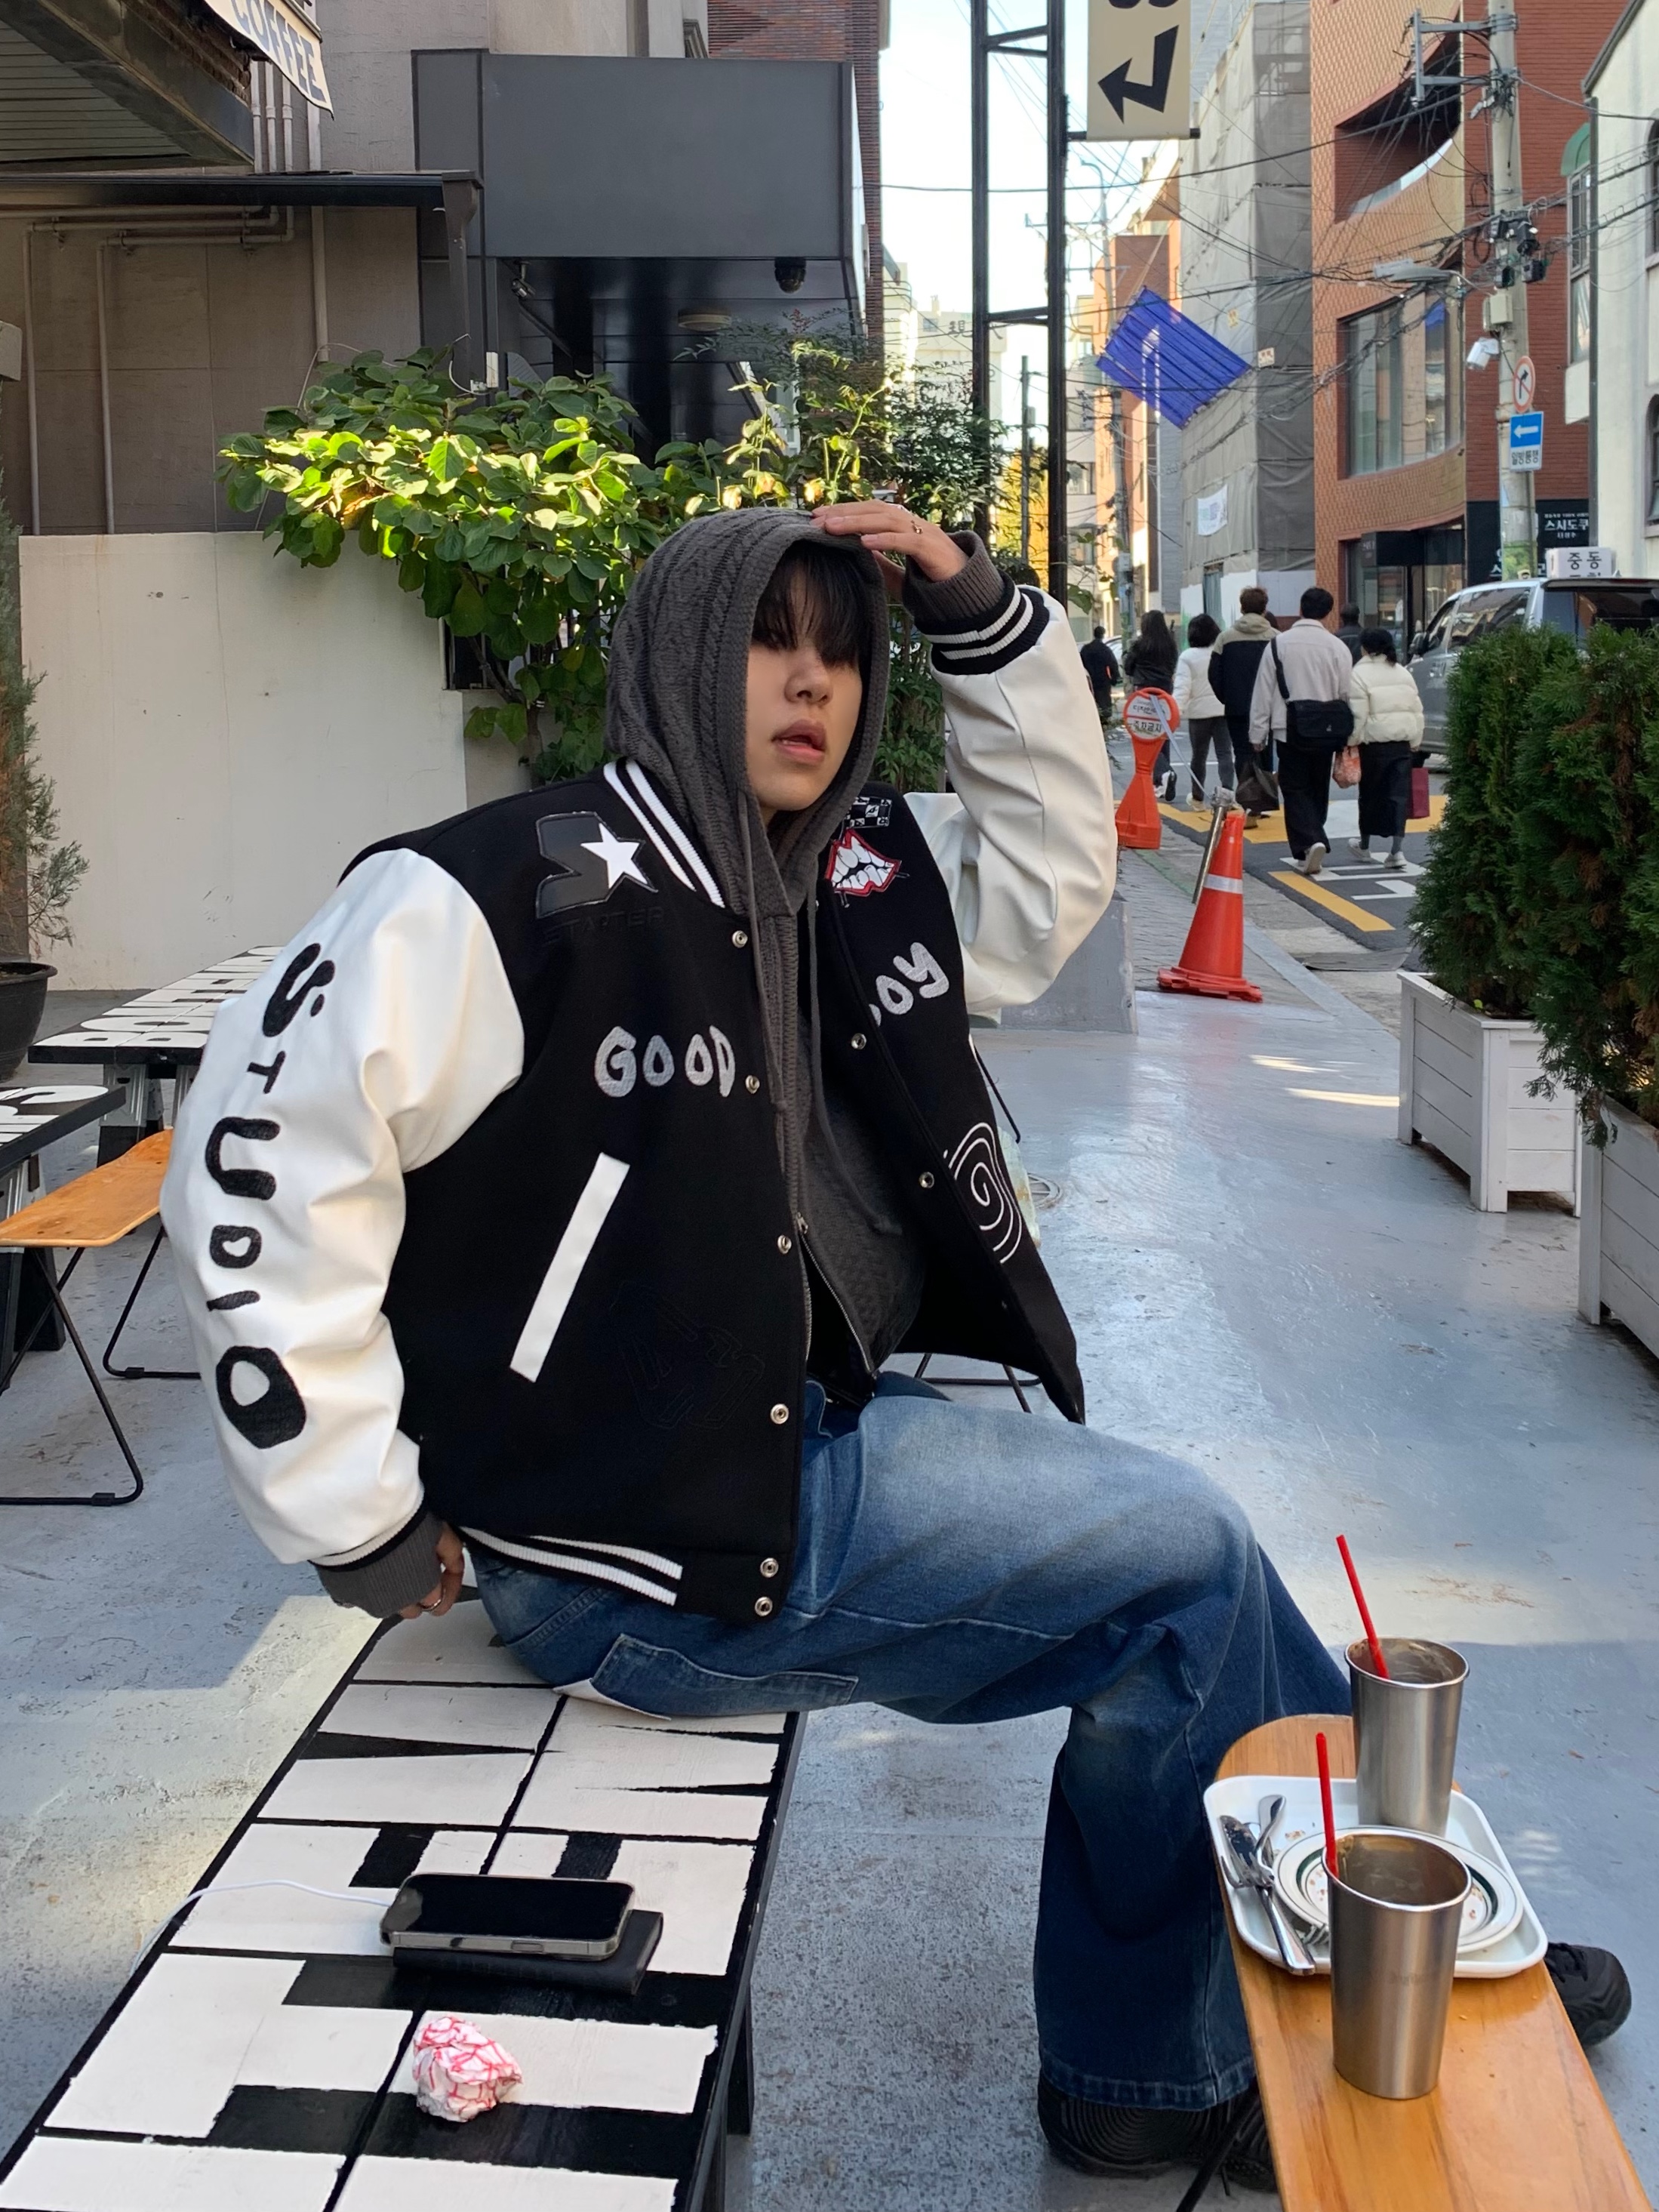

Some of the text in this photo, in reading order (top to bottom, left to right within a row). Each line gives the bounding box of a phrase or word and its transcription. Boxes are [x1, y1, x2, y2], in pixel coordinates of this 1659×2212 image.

[1512, 450, 1539, 465] 일방통행
[595, 1024, 736, 1098] GOOD
[205, 943, 335, 1450] STUDIO
